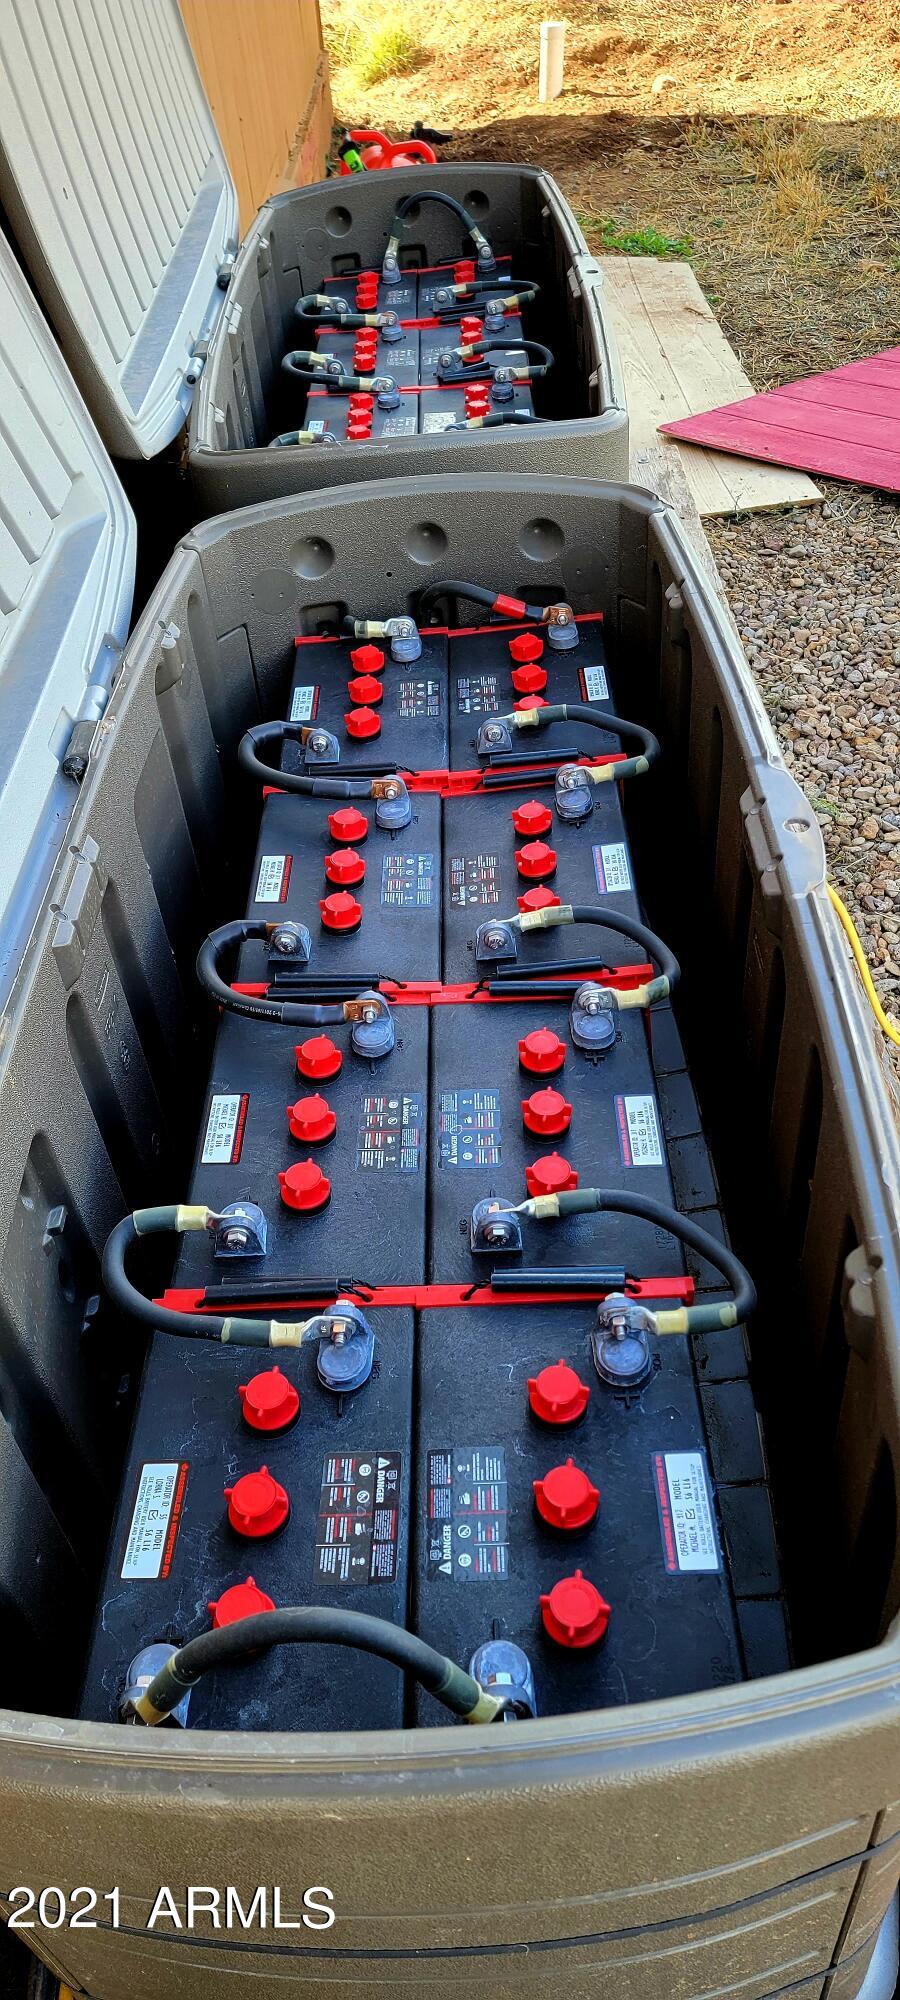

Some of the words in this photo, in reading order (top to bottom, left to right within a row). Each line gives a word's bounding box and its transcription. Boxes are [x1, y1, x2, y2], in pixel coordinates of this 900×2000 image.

[163, 1475, 174, 1499] OPERATOR
[375, 1470, 384, 1503] DANGER
[671, 1478, 682, 1499] MODEL
[152, 1529, 163, 1550] MODEL
[164, 1522, 177, 1564] INSPECTED
[442, 1524, 451, 1559] DANGER
